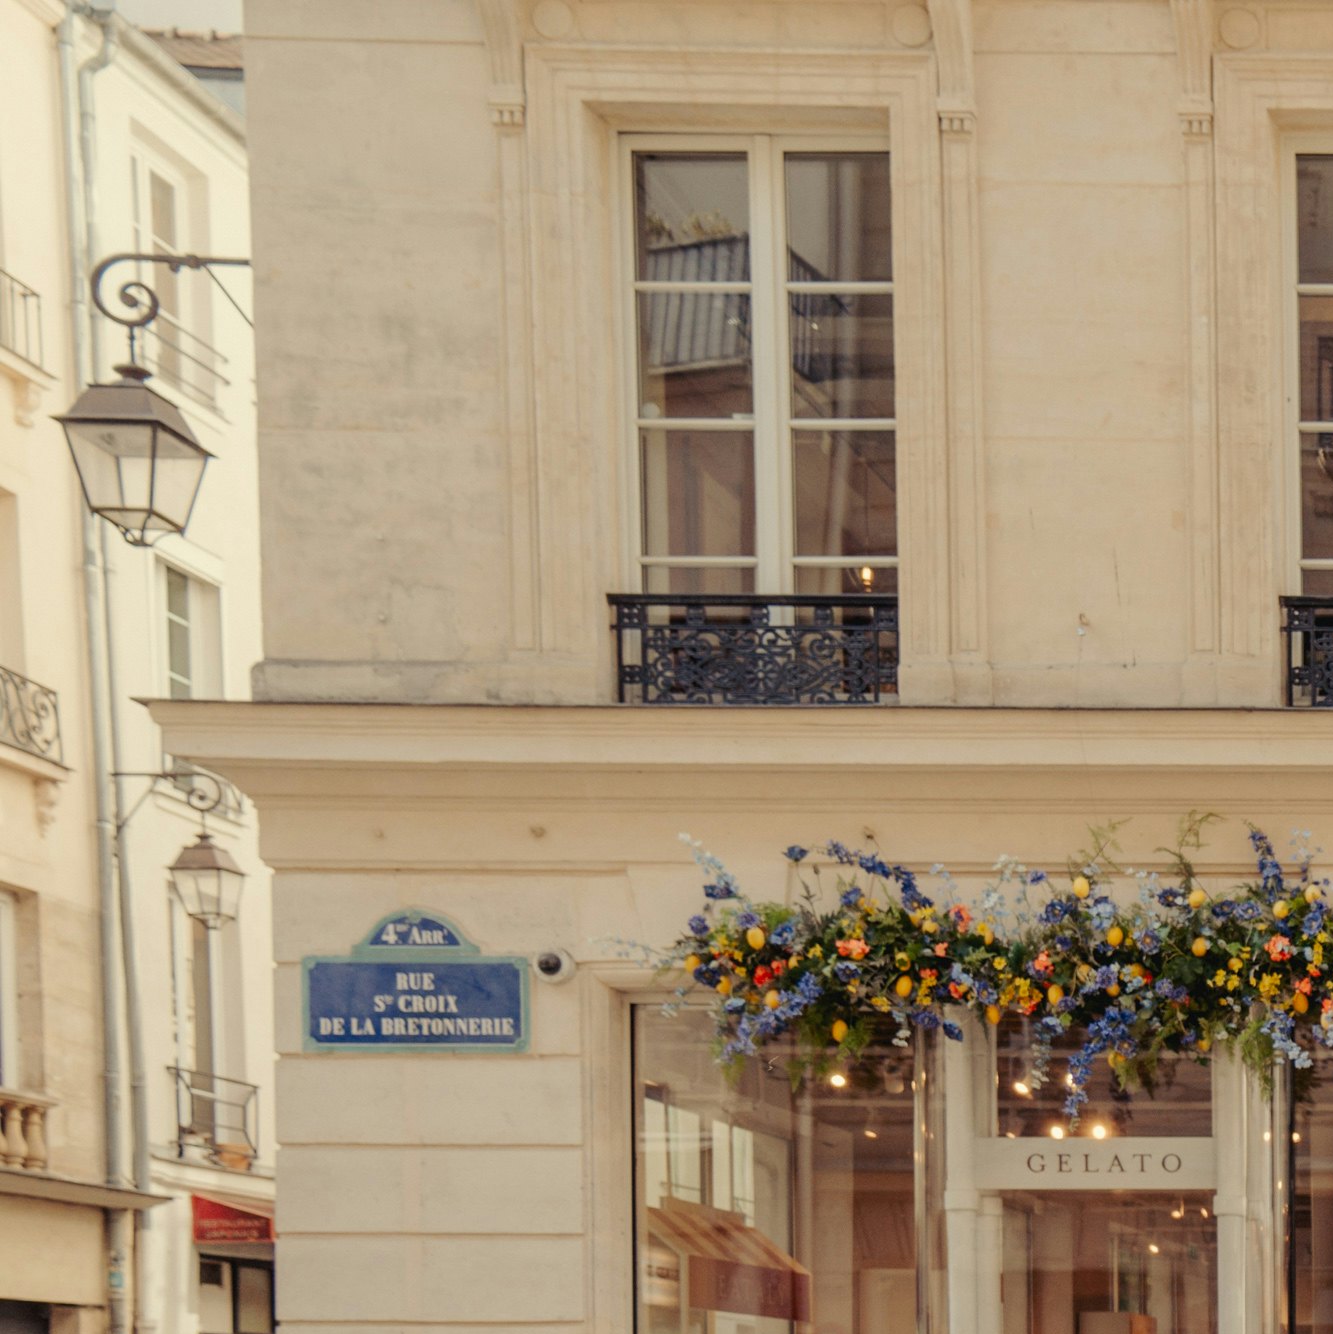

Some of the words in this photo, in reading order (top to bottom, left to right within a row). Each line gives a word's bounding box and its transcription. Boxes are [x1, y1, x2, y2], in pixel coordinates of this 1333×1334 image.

[395, 972, 435, 990] RUE
[397, 994, 459, 1013] CROIX
[319, 1017, 345, 1035] DE
[351, 1017, 376, 1035] LA
[380, 1017, 514, 1035] BRETONNERIE
[1026, 1153, 1182, 1173] GELATO
